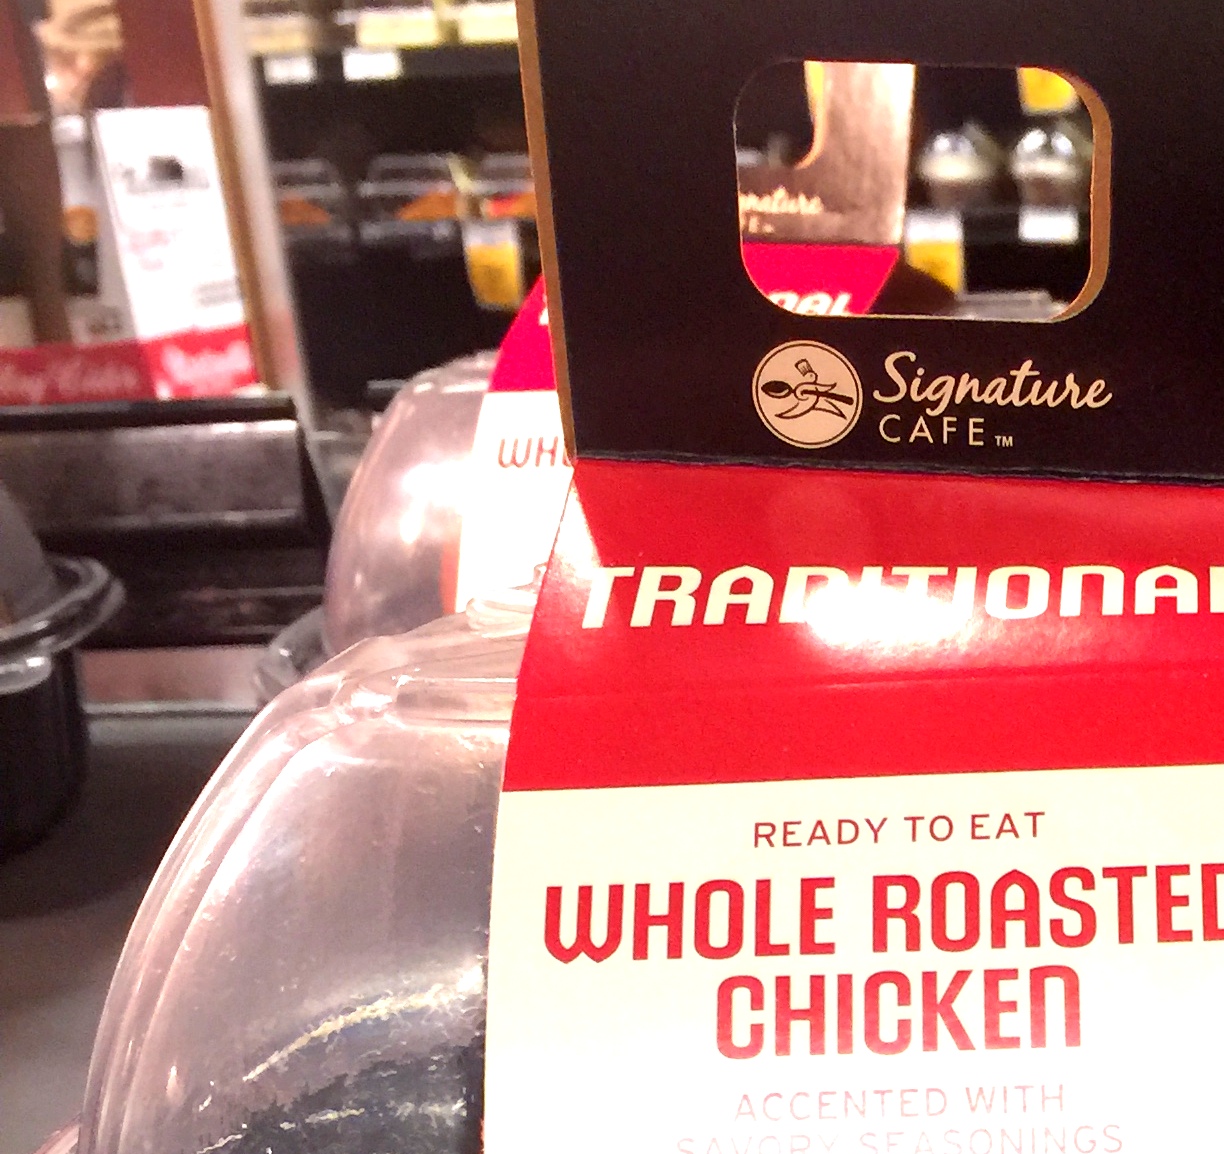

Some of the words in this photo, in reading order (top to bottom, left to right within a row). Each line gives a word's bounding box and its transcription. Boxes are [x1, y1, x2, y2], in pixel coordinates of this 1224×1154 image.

[873, 350, 1113, 417] Signature
[879, 414, 985, 446] CAFE
[498, 436, 573, 468] WH
[753, 816, 886, 849] READY
[903, 814, 955, 844] TO
[969, 811, 1046, 842] EAT
[543, 876, 837, 965] WHOLE
[715, 964, 1082, 1061] CHICKEN
[734, 1087, 948, 1122] ACCENTED
[964, 1083, 1065, 1115] WITH
